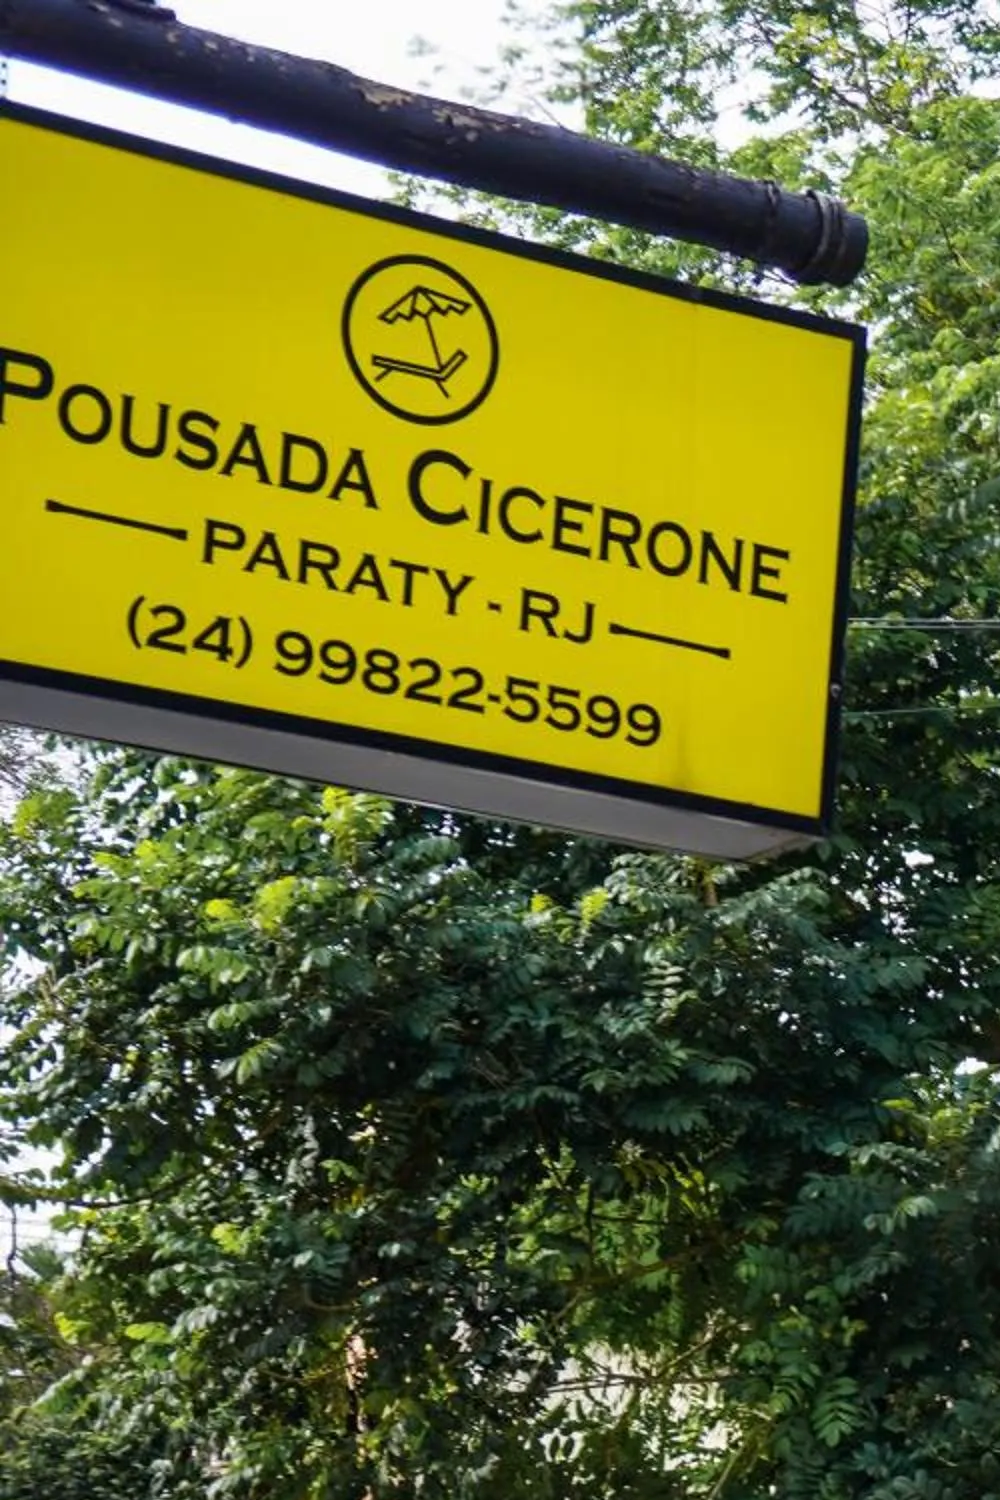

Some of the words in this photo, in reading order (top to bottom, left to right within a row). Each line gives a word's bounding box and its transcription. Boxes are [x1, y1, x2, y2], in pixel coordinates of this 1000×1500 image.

[0, 346, 379, 510] POUSADA
[407, 449, 790, 604] CICERONE
[202, 519, 473, 616] PARATY
[520, 588, 595, 644] RJ
[127, 596, 253, 669] (24)
[275, 630, 661, 747] 99822-5599
